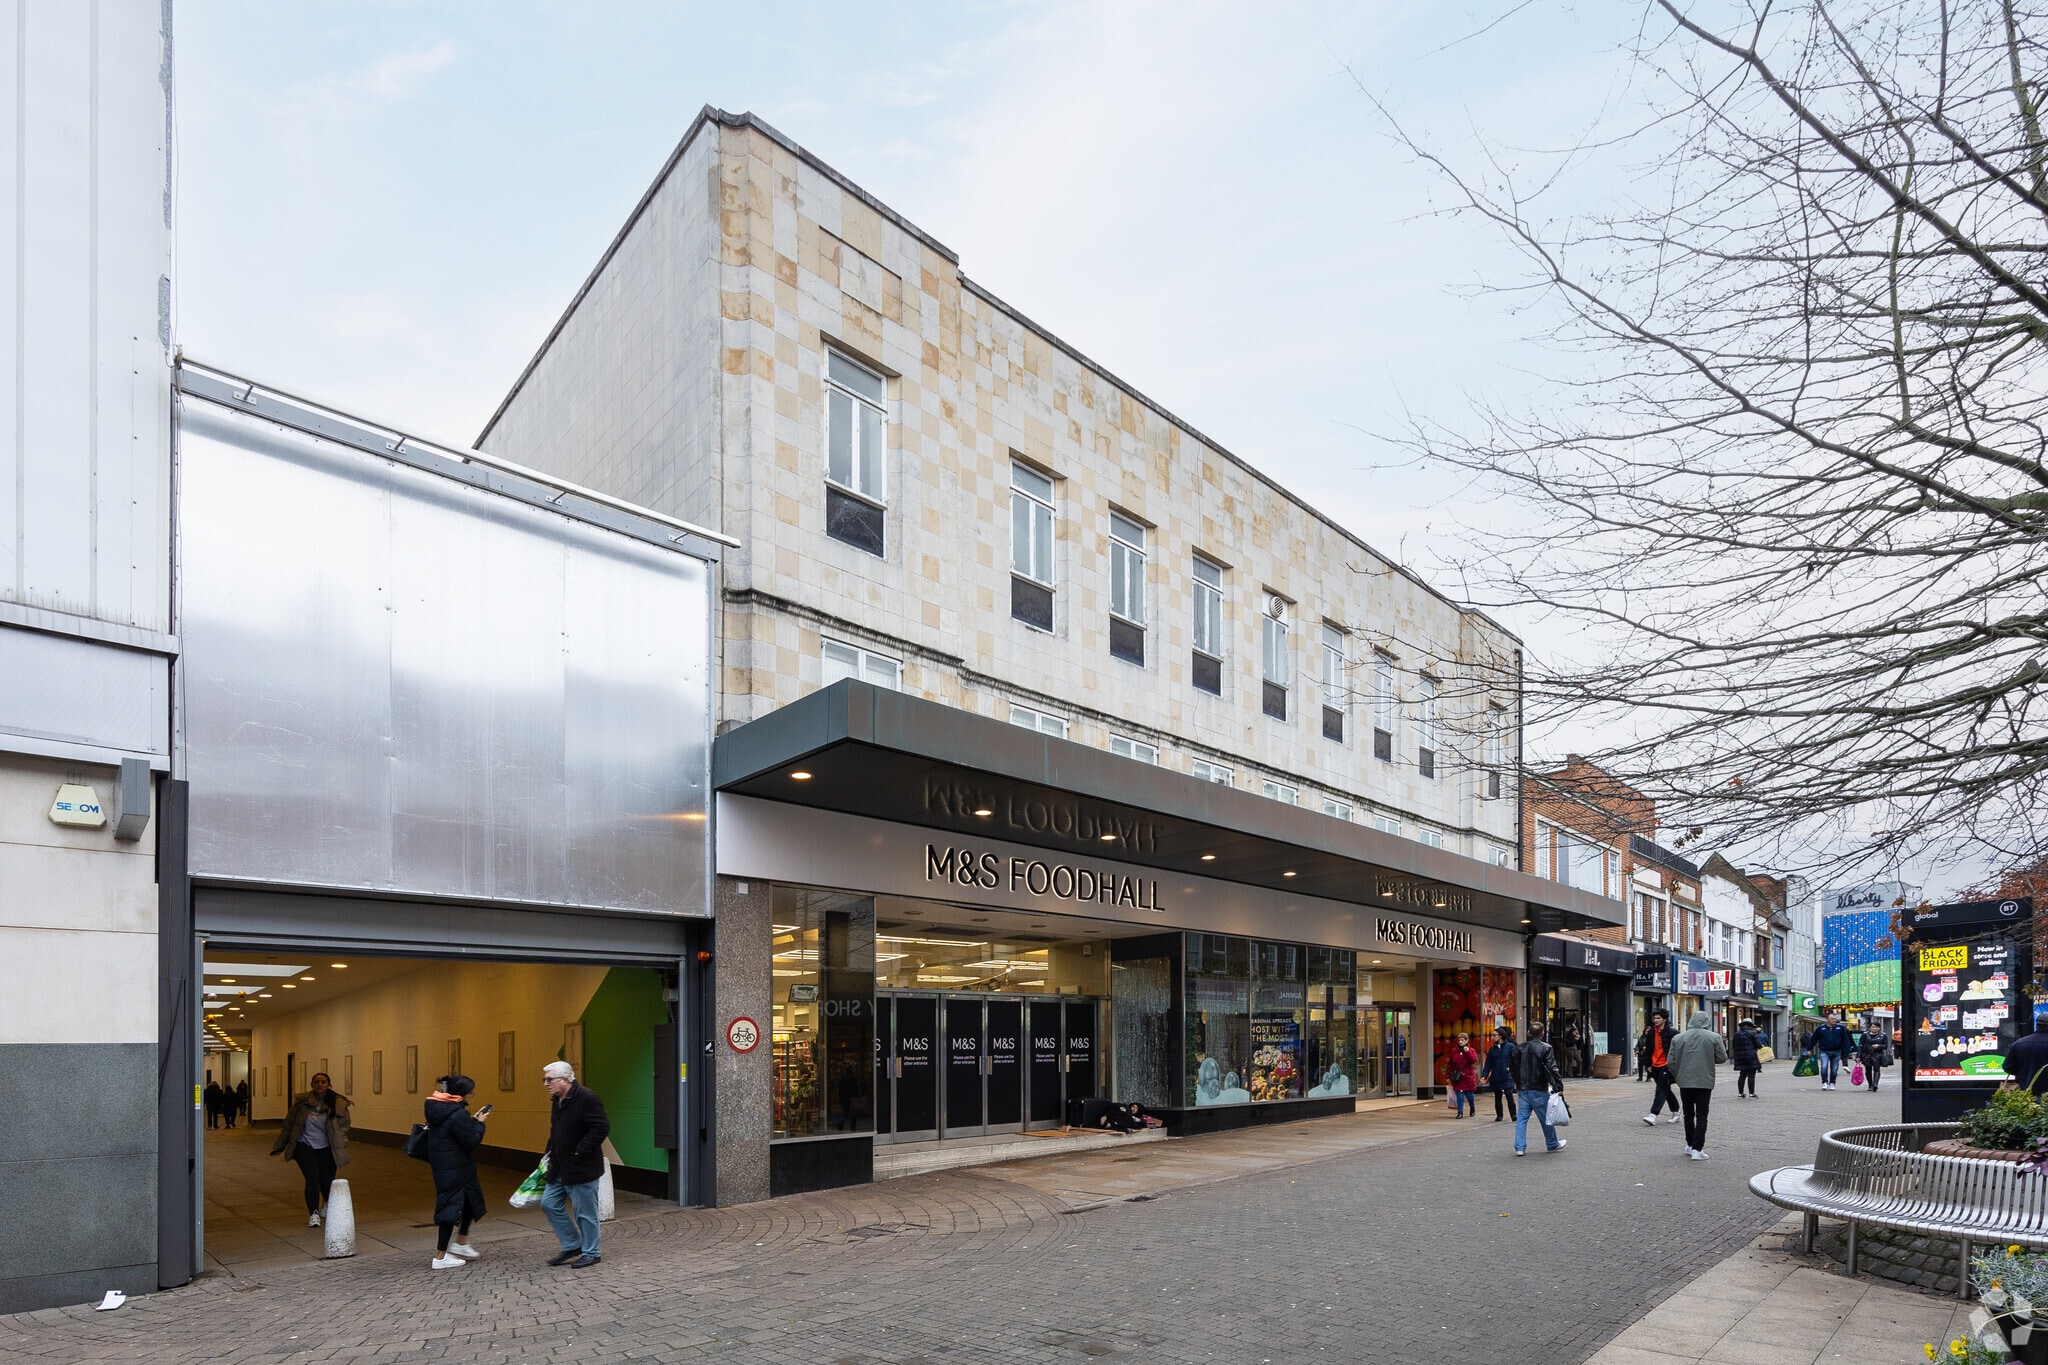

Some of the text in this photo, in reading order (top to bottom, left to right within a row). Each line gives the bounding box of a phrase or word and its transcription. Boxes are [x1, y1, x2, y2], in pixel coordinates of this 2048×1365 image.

[925, 844, 1166, 912] M&S FOODHALL
[1836, 892, 1884, 909] liberty
[2003, 904, 2015, 912] BT
[1914, 912, 1939, 922] global
[1375, 918, 1476, 954] M&S FOODHALL
[1923, 949, 1963, 960] BLACK
[1923, 959, 1962, 968] FRIDAY
[903, 1038, 928, 1050] M&S
[952, 1038, 976, 1050] M&S
[993, 1038, 1015, 1050] M&S
[1035, 1038, 1056, 1049] M&S
[1070, 1038, 1090, 1049] M&S
